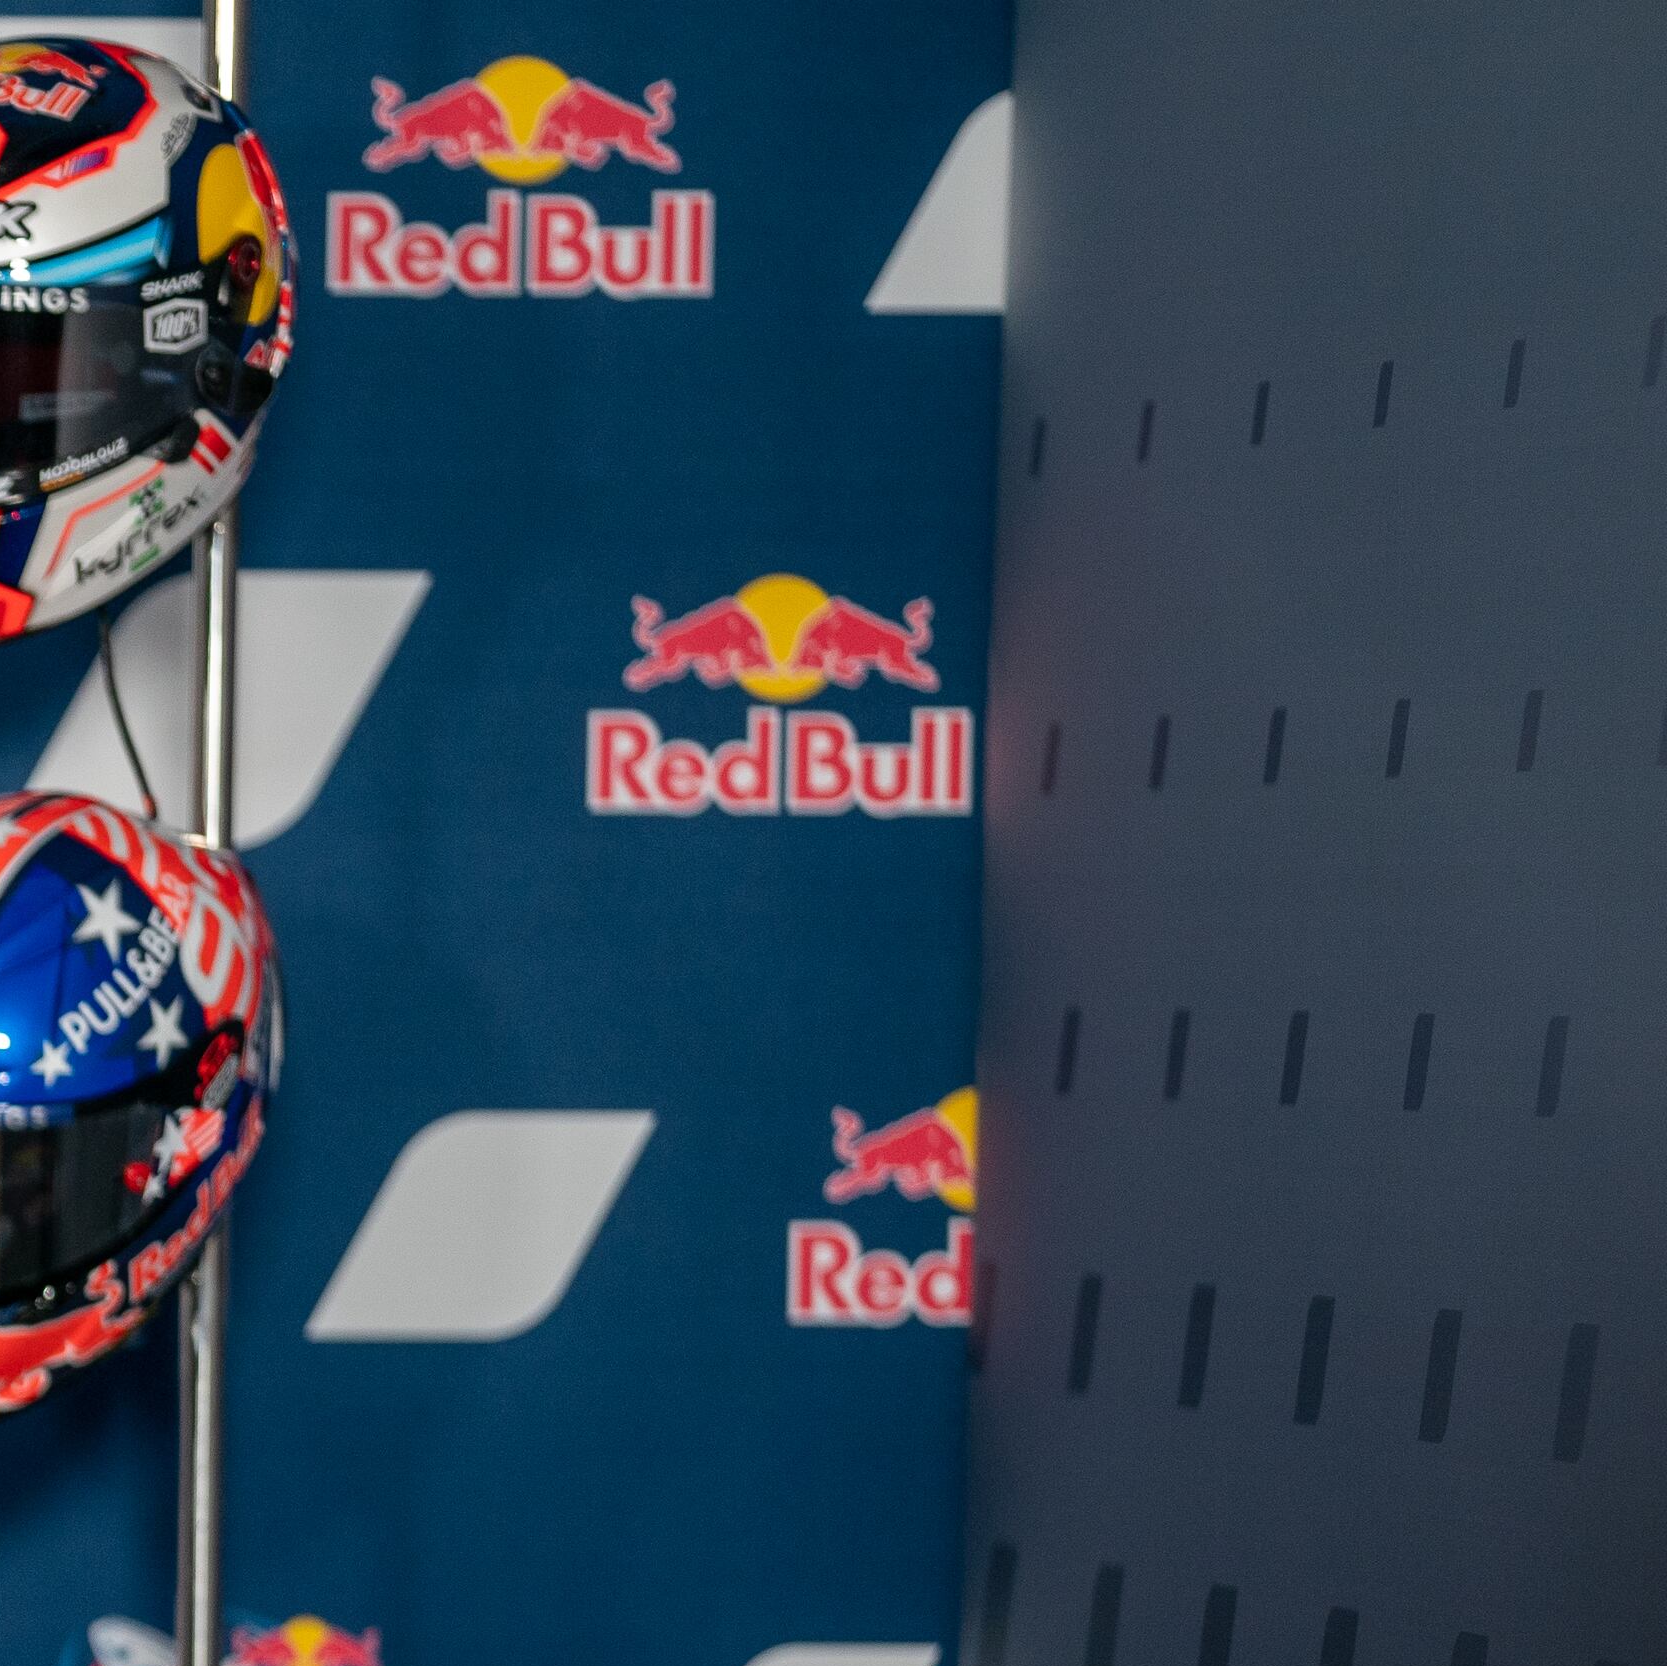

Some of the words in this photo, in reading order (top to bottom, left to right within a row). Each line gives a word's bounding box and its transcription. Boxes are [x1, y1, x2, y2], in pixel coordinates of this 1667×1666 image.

[141, 270, 205, 302] SHARK
[330, 193, 518, 292] Red
[528, 192, 710, 292] Bull
[153, 307, 199, 344] 100%
[590, 711, 778, 810] Red
[788, 710, 969, 809] Bull
[58, 873, 193, 1053] PULL&BEAR
[791, 1220, 973, 1321] Red
